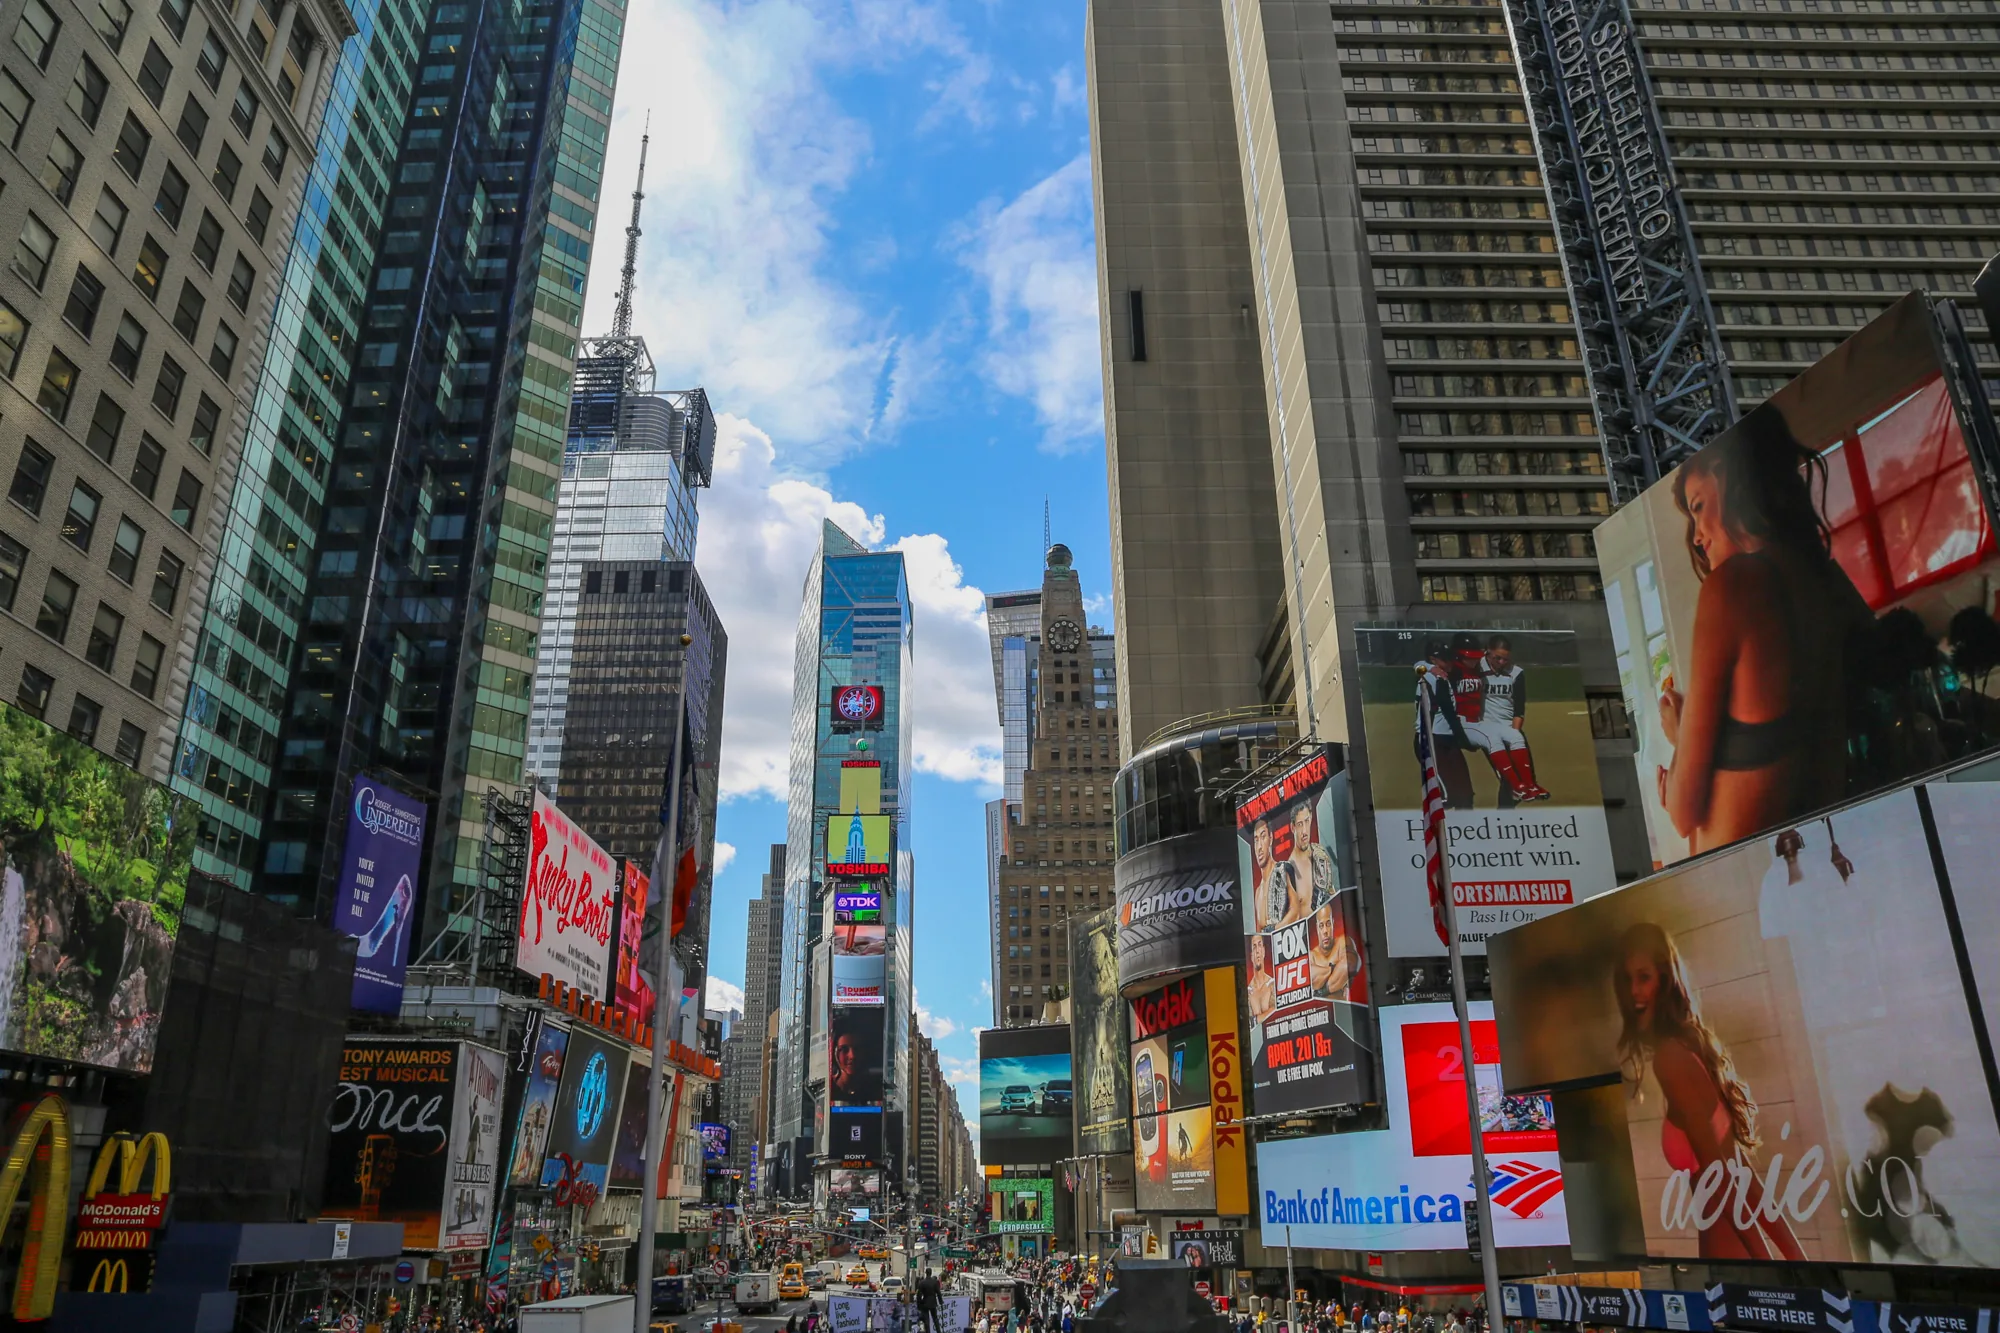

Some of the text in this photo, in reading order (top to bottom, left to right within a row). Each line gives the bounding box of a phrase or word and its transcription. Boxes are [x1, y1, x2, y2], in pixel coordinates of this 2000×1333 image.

[1591, 20, 1672, 240] OUTFITTERS
[1547, 0, 1648, 304] AMERICAN EAGLE
[1405, 815, 1579, 847] Hped injured
[1528, 844, 1580, 867] win.
[358, 857, 375, 872] YOU'RE
[828, 864, 889, 874] TOSHIBA
[356, 872, 375, 888] INVITED
[519, 811, 577, 945] Kinky
[571, 870, 614, 947] Boots
[353, 888, 370, 903] TO THE
[1453, 882, 1568, 904] ORTSMANSHIP
[847, 897, 878, 907] TDK
[351, 904, 363, 917] BALL
[1142, 902, 1234, 927] driving emotion
[1470, 910, 1496, 924] Pass
[1500, 910, 1509, 923] It
[1272, 922, 1308, 965] FOX
[1276, 958, 1309, 992] UFC
[1276, 986, 1312, 1008] SATURDAY
[1134, 979, 1196, 1040] Kodak
[343, 1050, 452, 1065] TONY AWARDS
[1267, 1032, 1332, 1069] APRIL 20 8ET
[339, 1067, 450, 1082] EST MUSICAL
[1277, 1069, 1288, 1084] LIVE
[1291, 1066, 1302, 1081] FREE
[1309, 1061, 1324, 1078] FOX
[1210, 1031, 1241, 1149] Kodak
[454, 1163, 491, 1182] NEWSIES
[81, 1204, 160, 1216] McDonald's
[1266, 1184, 1462, 1224] Bank of America
[1174, 1231, 1239, 1239] MARQUIS
[1208, 1241, 1233, 1255] Jekyll
[1212, 1251, 1237, 1265] Hyde
[1599, 1296, 1622, 1306] WE'RE
[1748, 1290, 1796, 1301] AMERICAN EAGLE
[834, 1301, 851, 1311] Long
[1600, 1306, 1620, 1316] OPEN
[835, 1311, 847, 1319] live
[1736, 1306, 1816, 1325] ENTER HERE
[1925, 1315, 1967, 1330] WE'RE
